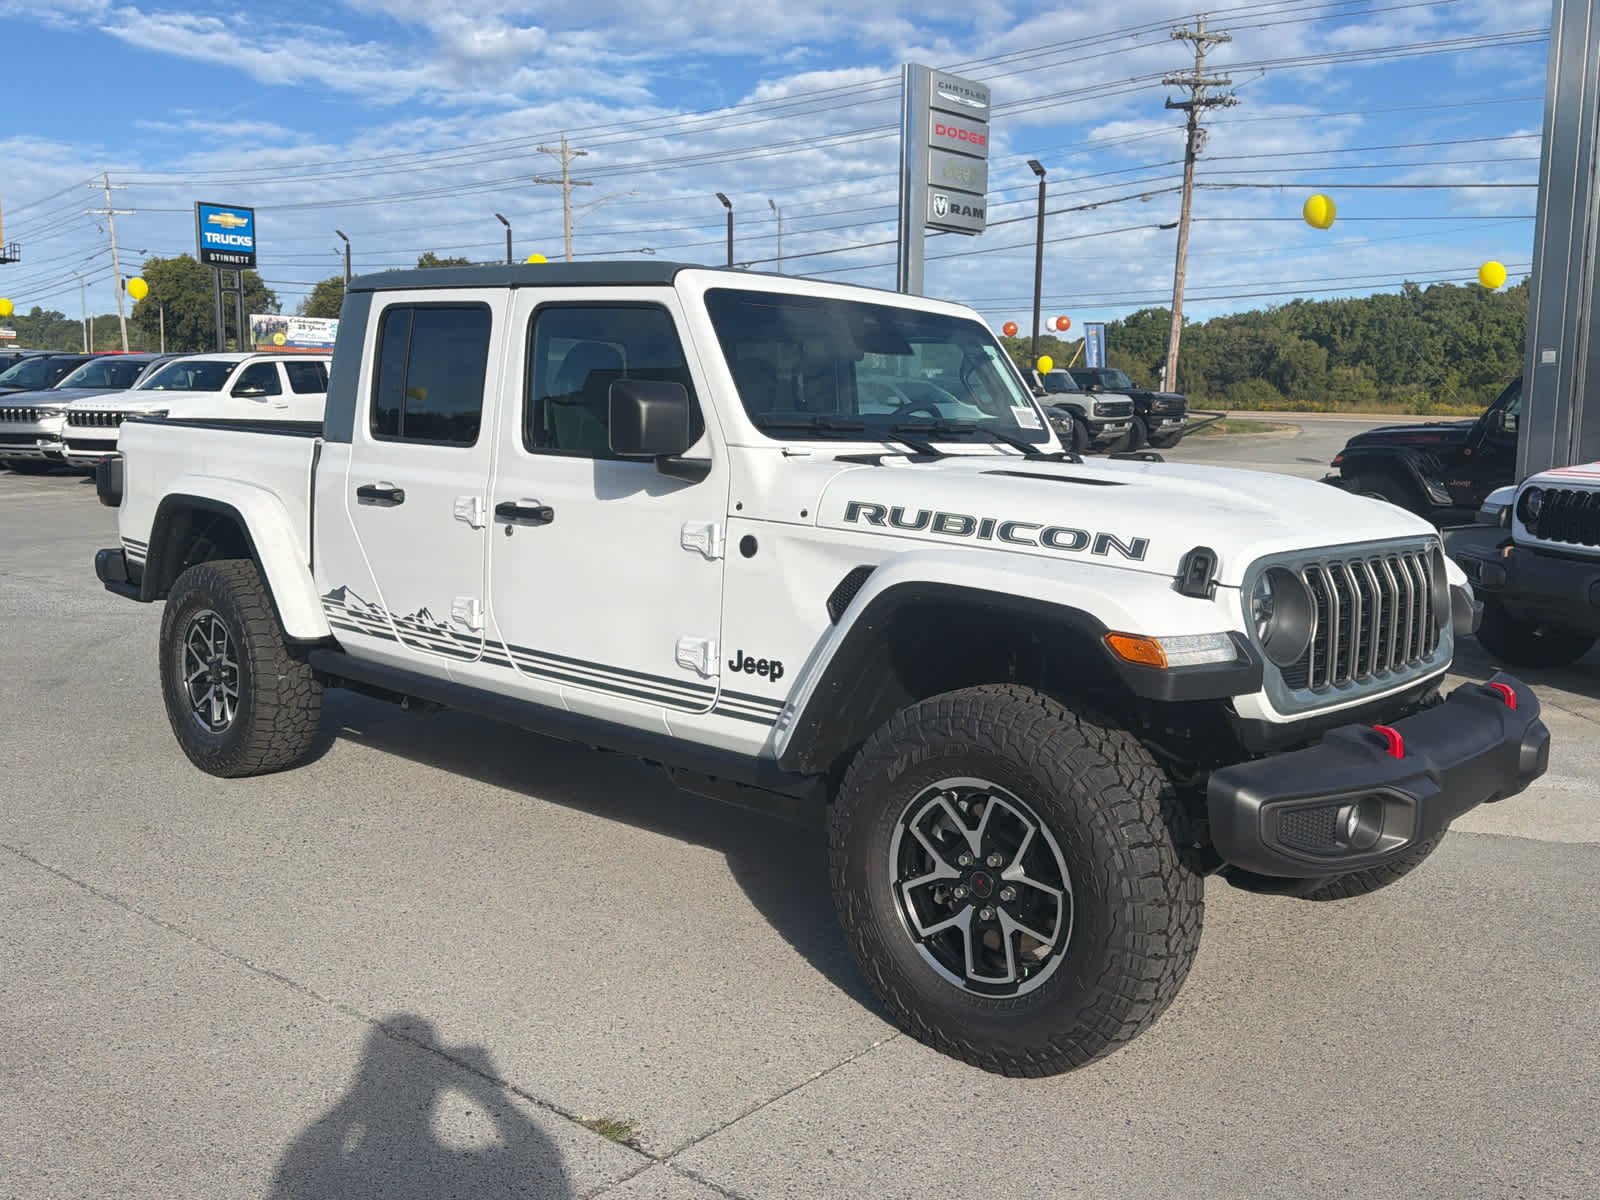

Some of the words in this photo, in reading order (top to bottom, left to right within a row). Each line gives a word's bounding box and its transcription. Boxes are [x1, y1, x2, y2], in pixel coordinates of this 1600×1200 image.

[937, 81, 986, 100] CHRYSLER
[935, 124, 986, 146] DODGE
[950, 203, 984, 219] RAM
[204, 232, 253, 247] TRUCKS
[210, 253, 249, 264] STINNETT
[843, 500, 1151, 562] RUBICON
[728, 649, 784, 682] Jeep
